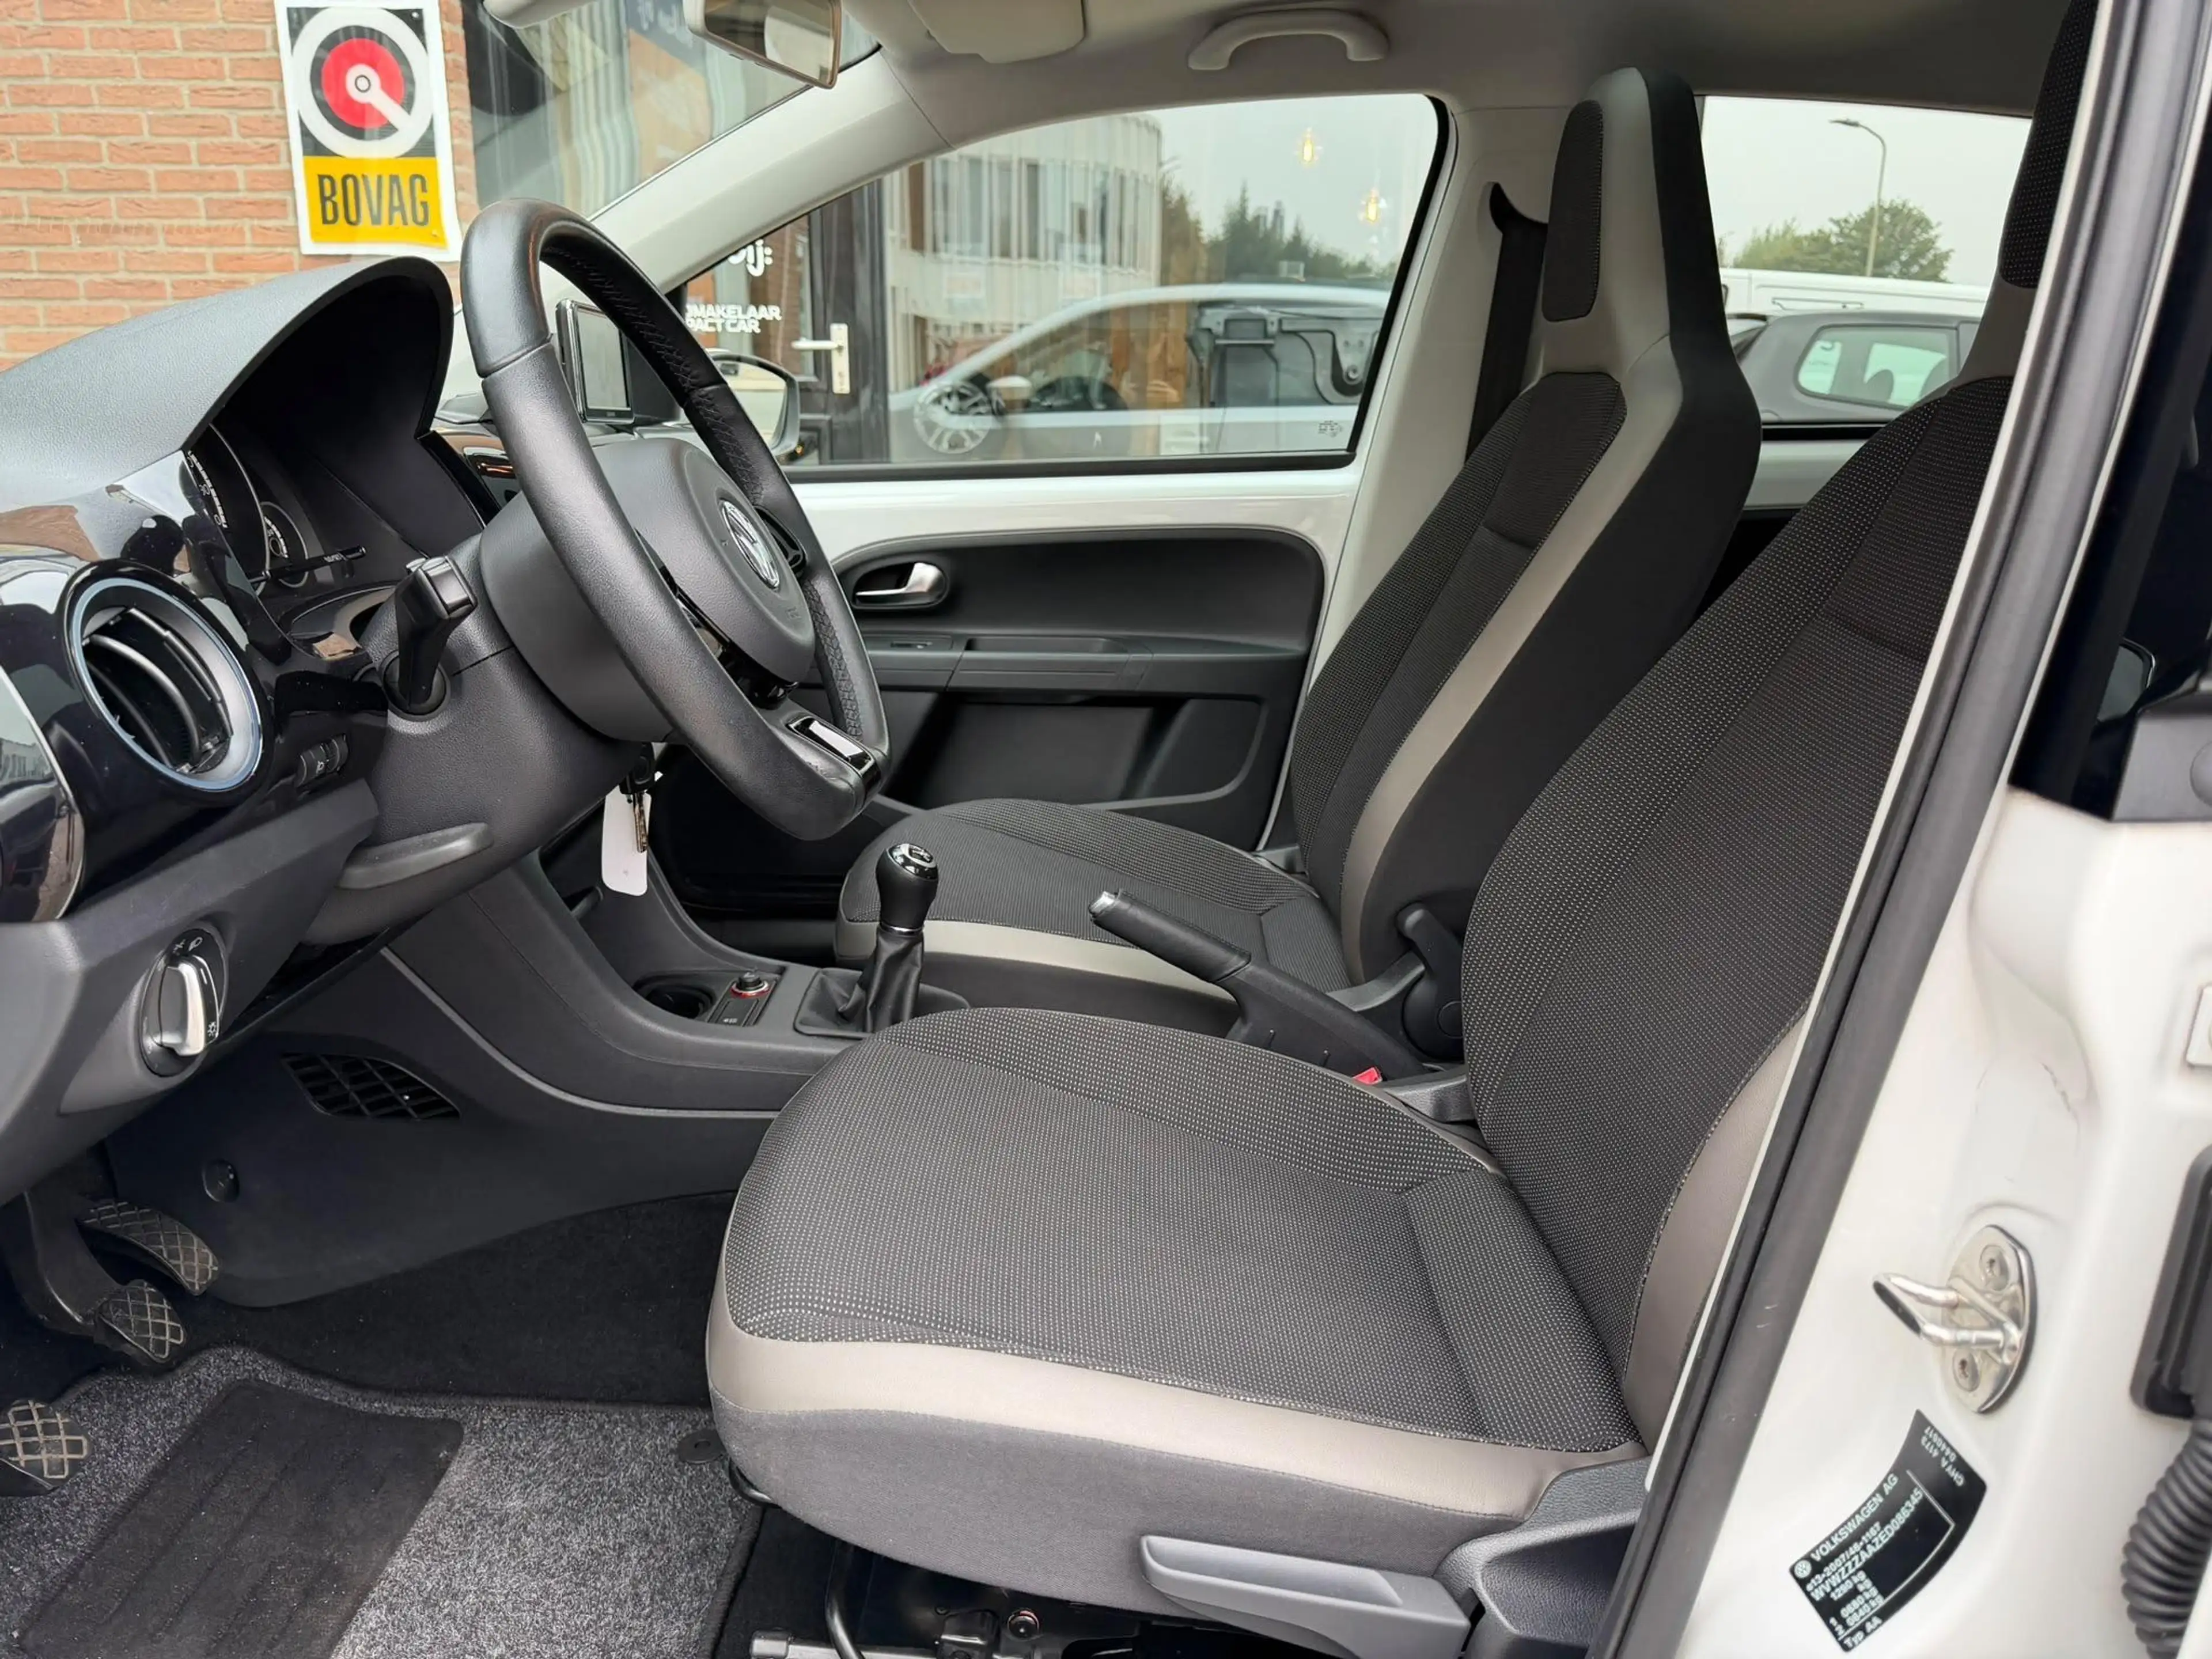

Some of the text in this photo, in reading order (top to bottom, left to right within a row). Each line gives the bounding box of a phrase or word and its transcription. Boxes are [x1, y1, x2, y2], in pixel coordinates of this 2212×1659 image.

[317, 174, 429, 226] BOVAG
[725, 317, 761, 333] CAR
[1810, 1472, 1899, 1562] VOLKSWAGEN AG
[1843, 1630, 1865, 1649] Typ
